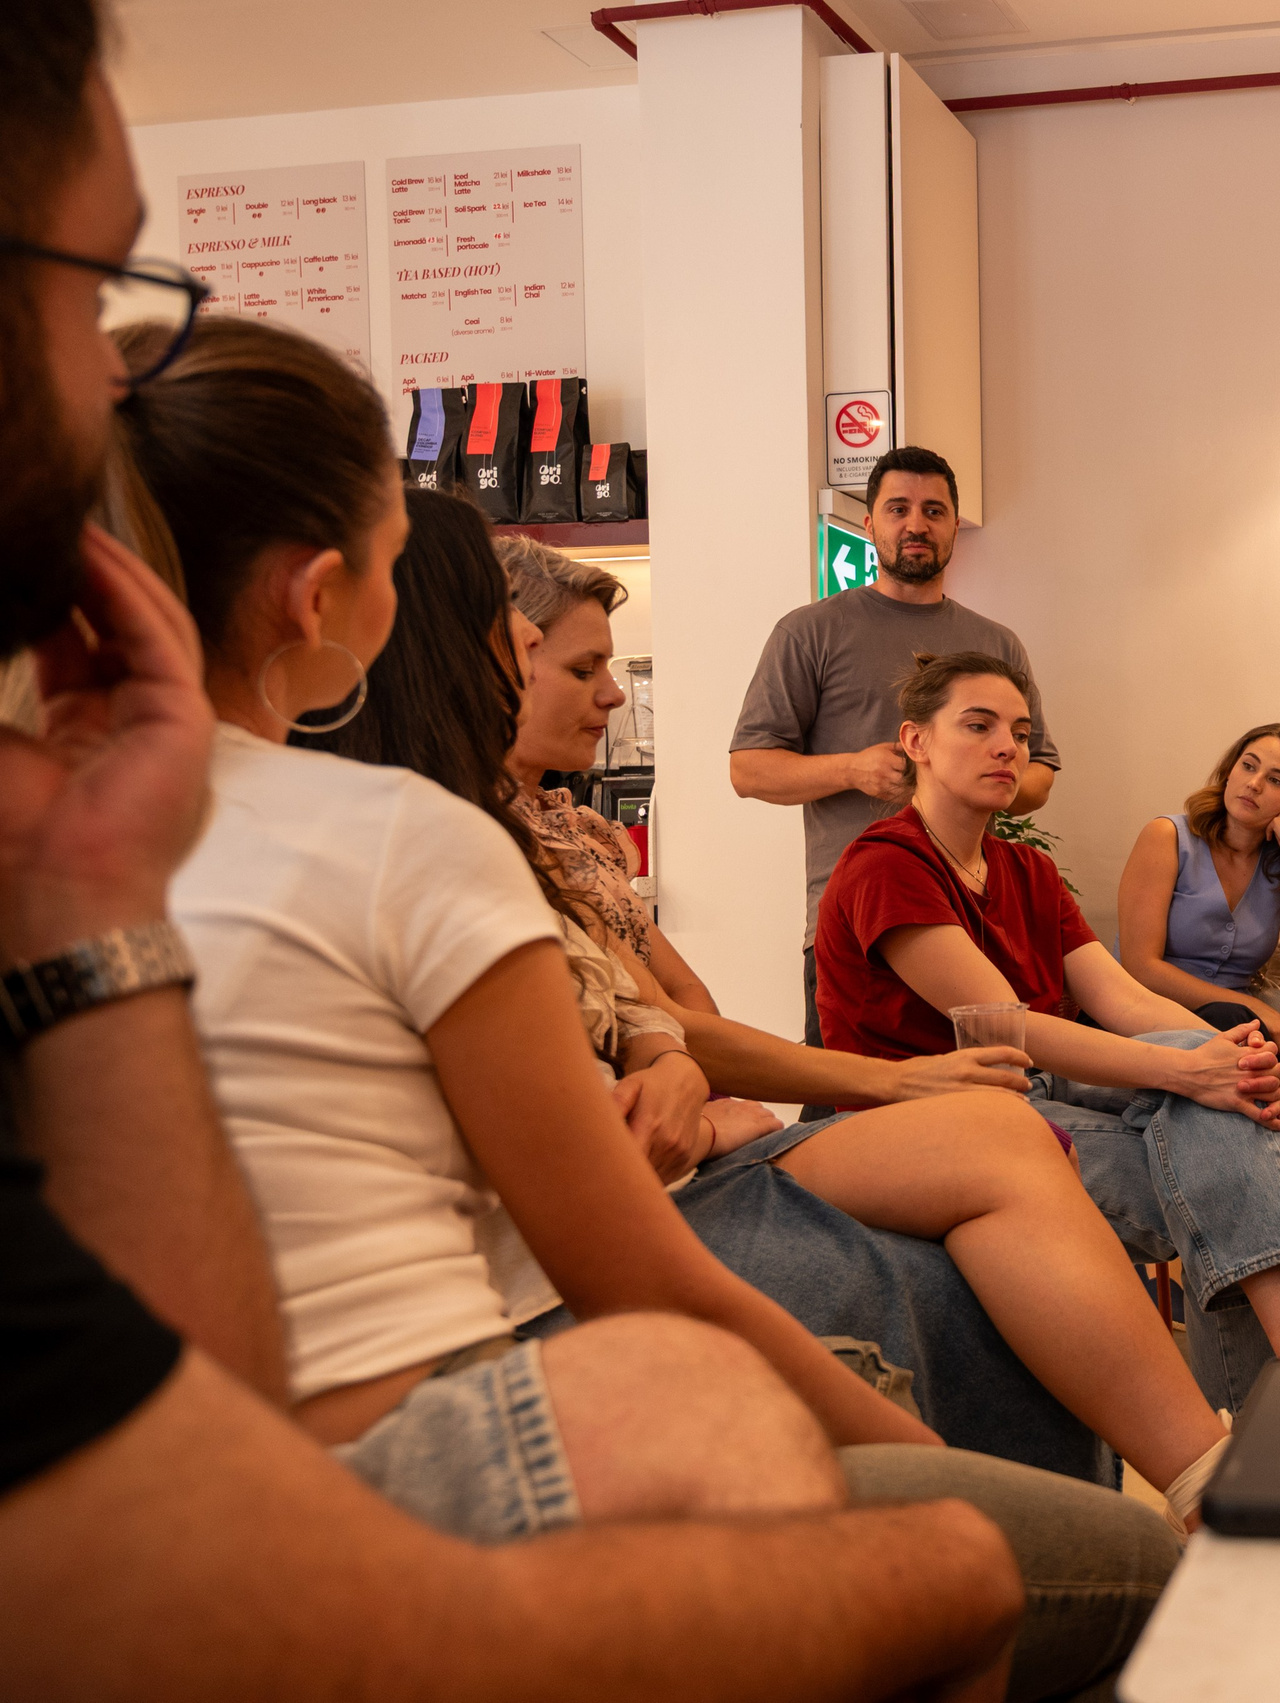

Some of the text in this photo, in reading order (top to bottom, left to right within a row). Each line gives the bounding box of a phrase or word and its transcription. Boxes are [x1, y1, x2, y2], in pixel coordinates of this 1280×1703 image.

[517, 169, 551, 177] Milkshake
[392, 178, 406, 186] Cold
[187, 185, 245, 200] ESPRESSO
[246, 202, 268, 210] Double
[467, 205, 487, 214] Spark
[187, 208, 206, 216] Single
[188, 235, 292, 254] ESPRESSO & MILK
[457, 242, 489, 252] portocale
[242, 259, 280, 269] Cappuccino
[397, 262, 501, 281] TEA BASED (HOT)
[455, 289, 479, 298] English
[244, 299, 277, 307] Machiatto
[400, 352, 449, 364] PACKED
